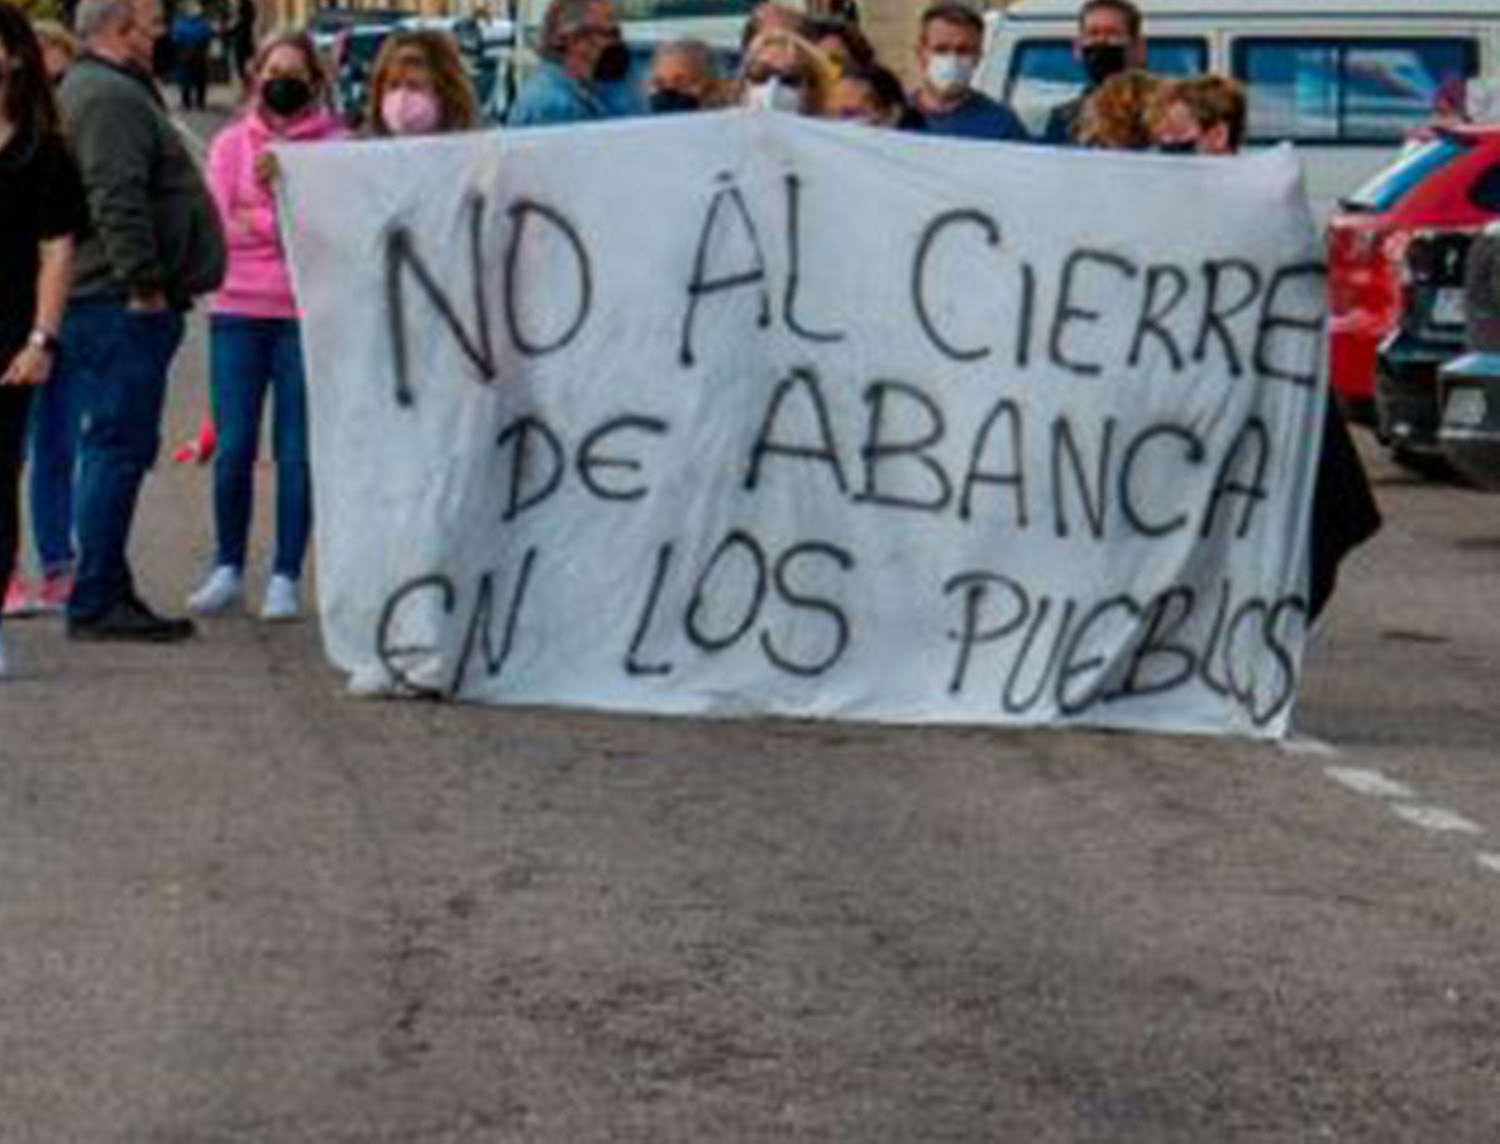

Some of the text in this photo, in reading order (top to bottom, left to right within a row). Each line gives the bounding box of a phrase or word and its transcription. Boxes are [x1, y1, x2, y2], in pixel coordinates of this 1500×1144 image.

[384, 170, 1329, 407] NO AL CIERRE
[496, 366, 1269, 540] DE ABANCA
[374, 527, 1308, 727] EN LOS PUEBLOS
